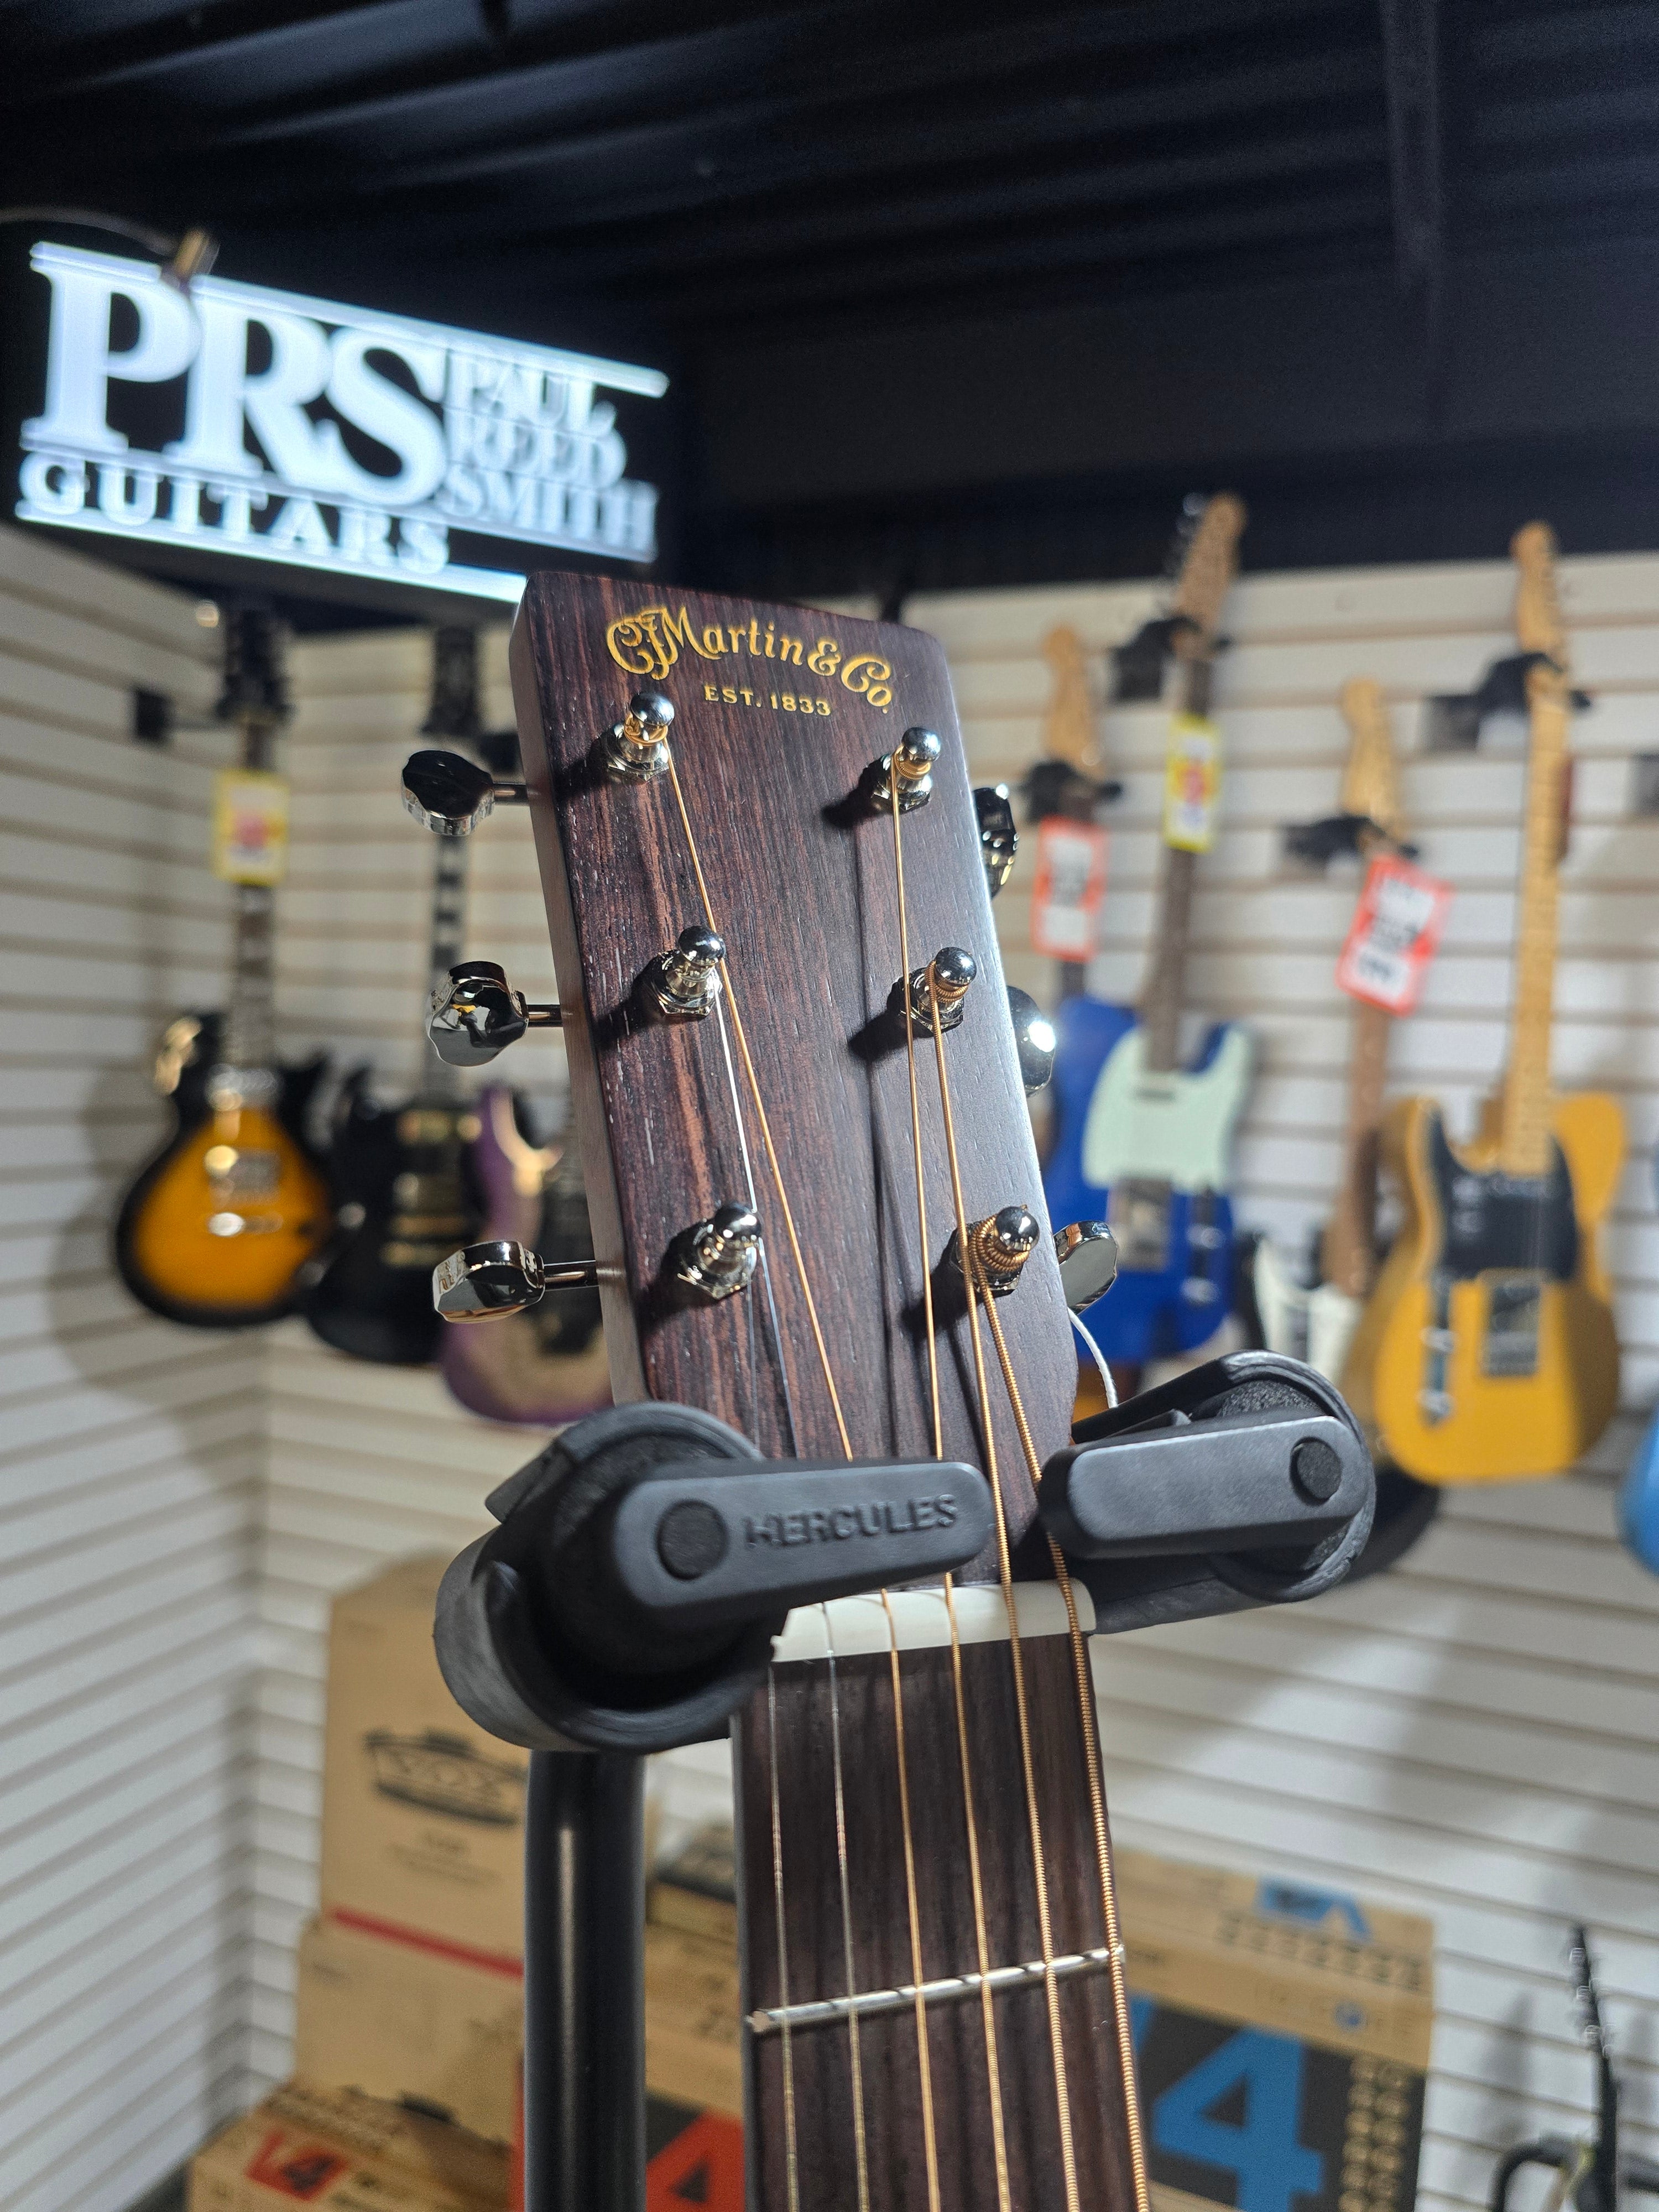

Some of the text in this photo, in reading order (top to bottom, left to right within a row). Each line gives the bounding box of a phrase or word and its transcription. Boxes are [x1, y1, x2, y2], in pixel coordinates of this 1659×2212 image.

[20, 252, 444, 507] PRS
[19, 451, 449, 575] GUITARS
[703, 684, 830, 716] EST. 1833
[744, 1493, 958, 1548] HERCULES
[1131, 1995, 1323, 2212] 4
